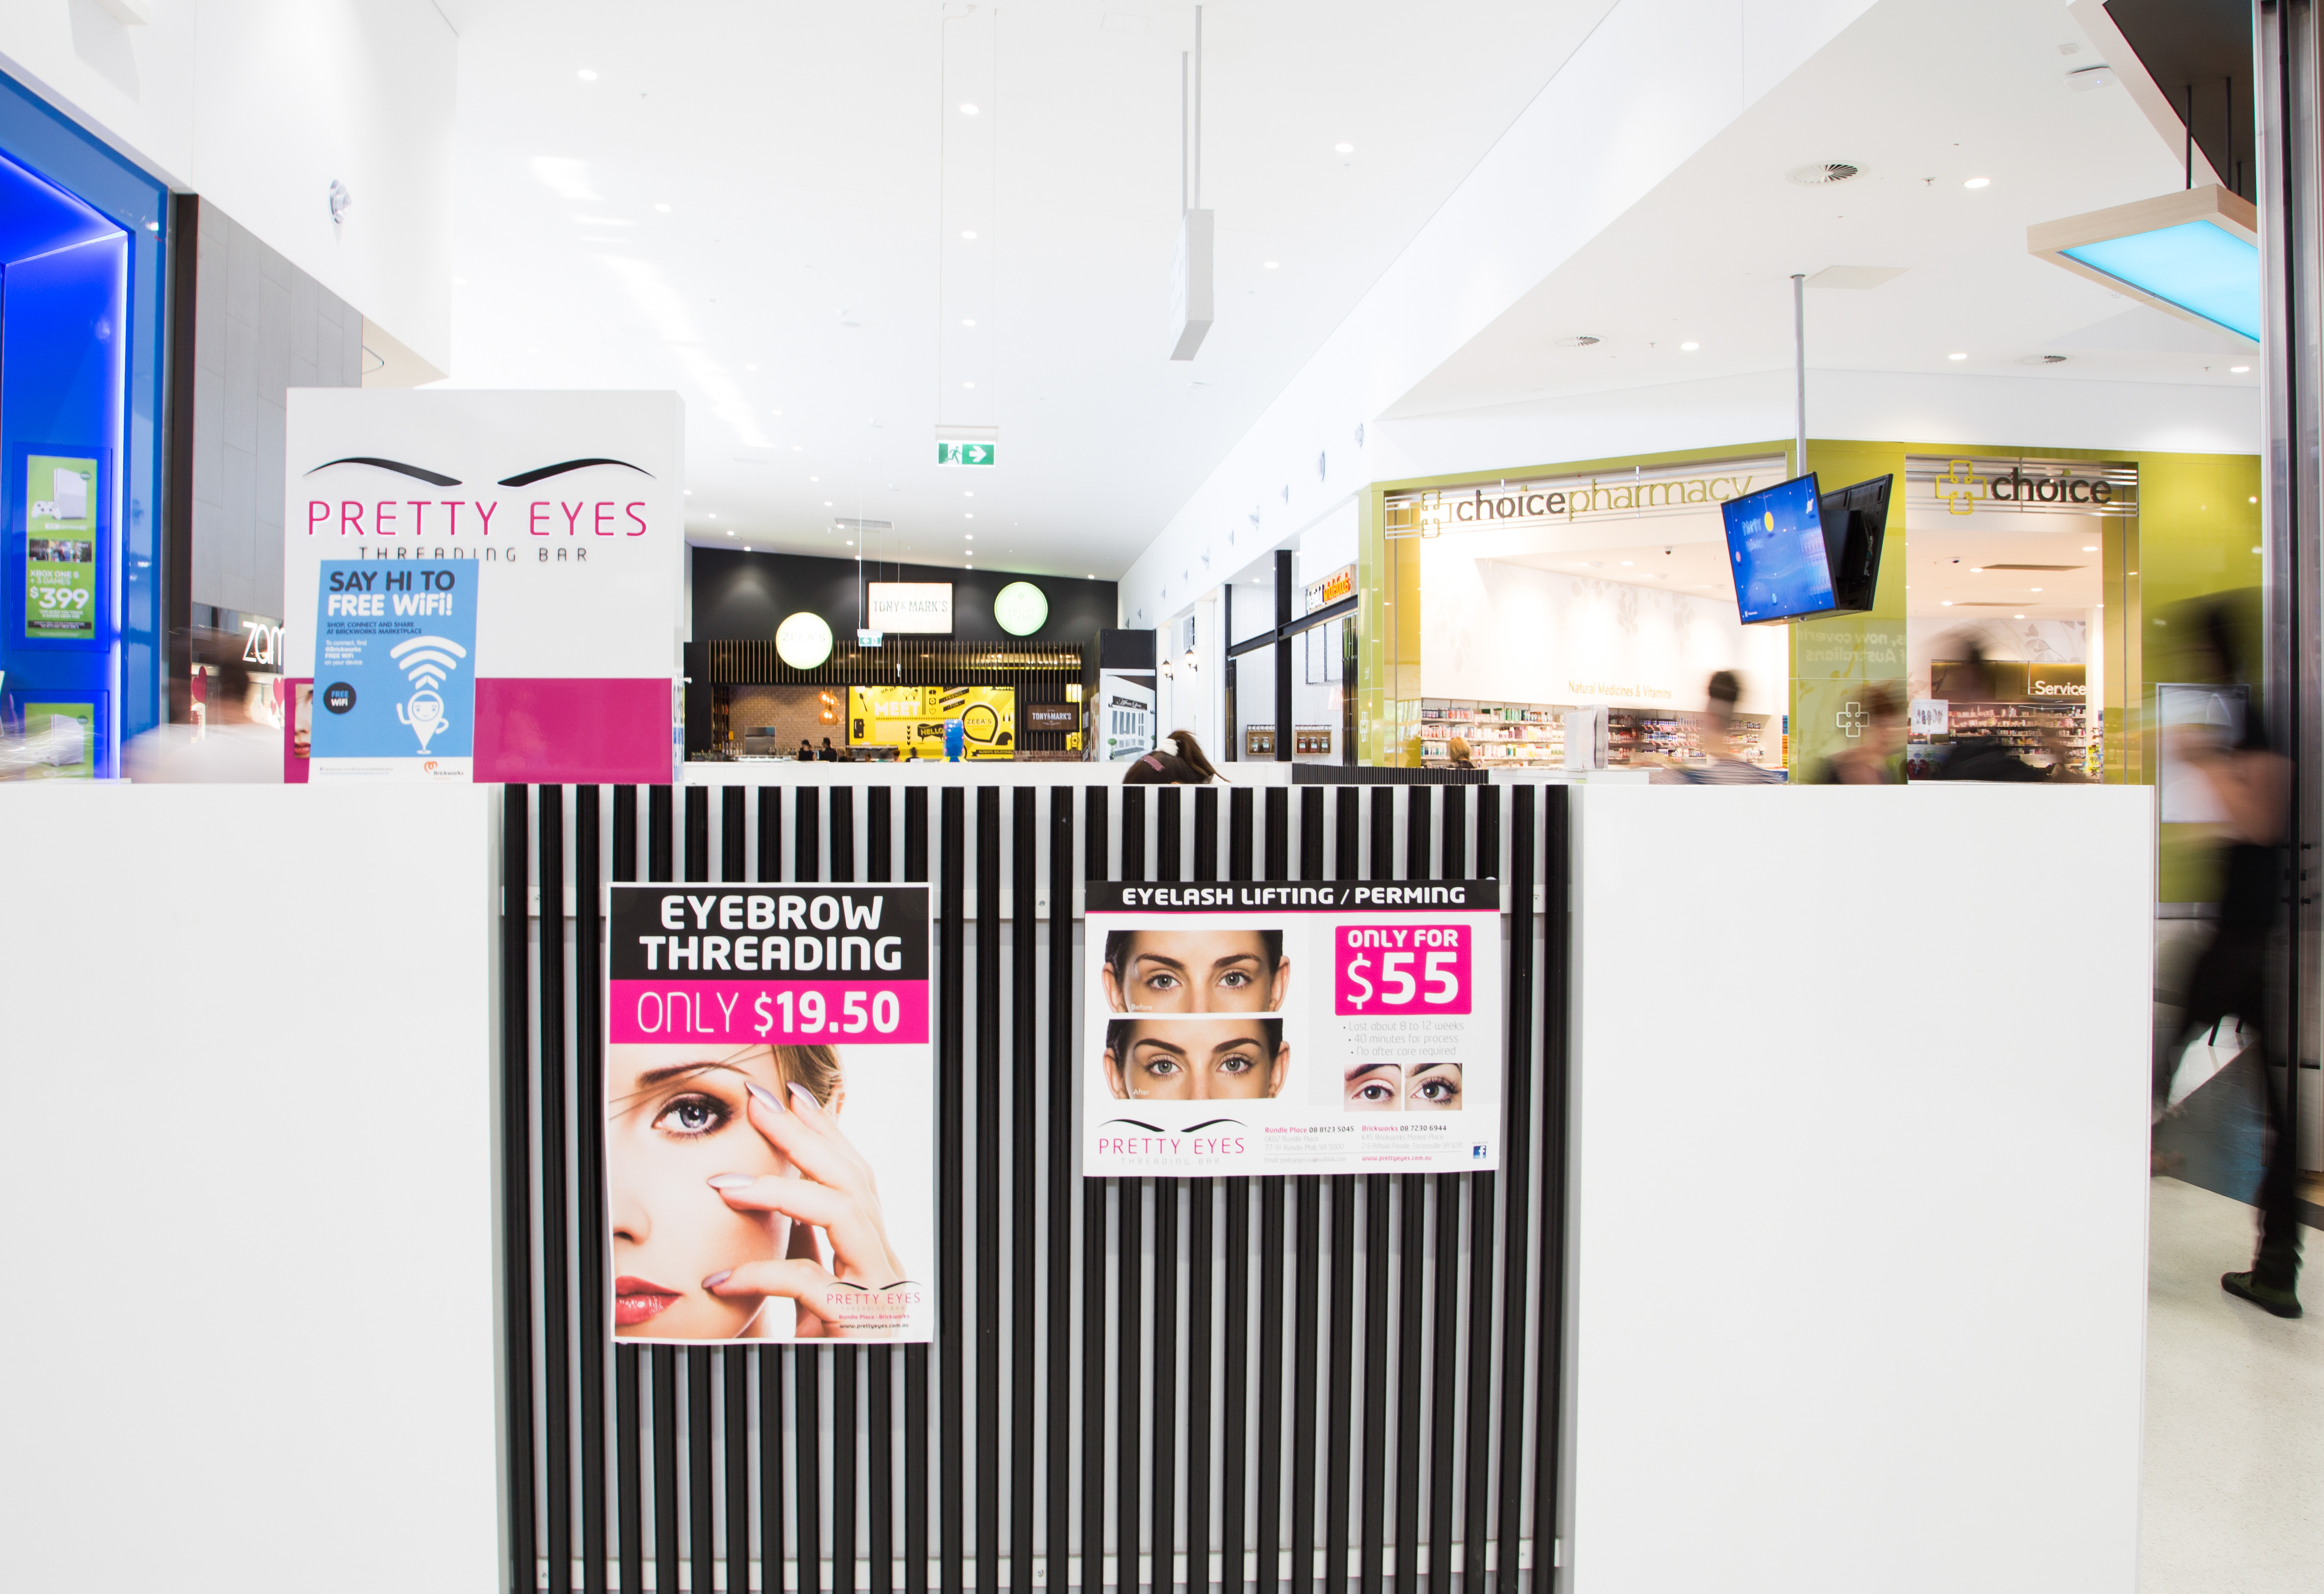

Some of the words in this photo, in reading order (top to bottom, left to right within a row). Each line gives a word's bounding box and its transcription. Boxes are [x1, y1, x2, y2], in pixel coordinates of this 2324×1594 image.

[1991, 467, 2112, 504] choice
[308, 500, 498, 536] PRETTY
[529, 501, 647, 537] EYES
[358, 547, 516, 561] THREADING
[539, 547, 587, 562] BAR
[43, 577, 71, 586] GAMES
[54, 570, 72, 578] ONE
[329, 571, 377, 592] SAY
[386, 571, 412, 591] HI
[421, 570, 455, 591] TO
[30, 586, 89, 610] $399
[327, 594, 384, 617] FREE
[392, 592, 452, 617] WiFi!
[873, 601, 899, 612] TONY
[909, 601, 948, 612] MARK'S
[1568, 680, 1596, 694] Natural
[1598, 682, 1634, 697] Medicines
[1636, 685, 1641, 697] &
[1643, 685, 1672, 699] Vitamins
[2035, 680, 2086, 695] Service
[331, 698, 348, 707] WiFi
[875, 701, 920, 716] MEET
[1122, 888, 1233, 906] EYELASH
[1241, 887, 1334, 905] LIFTING
[1340, 888, 1350, 905] /
[1354, 886, 1466, 905] PERMING
[661, 895, 883, 930] EYEBROW
[1348, 930, 1408, 948] ONLY
[1414, 928, 1459, 947] FOR
[639, 935, 902, 971] THREADING
[1347, 951, 1459, 1010] $55
[638, 991, 739, 1033] ONLY
[754, 990, 900, 1037] $19.50
[1349, 1022, 1367, 1031] Last
[1371, 1022, 1397, 1031] about
[1399, 1021, 1407, 1031] 8
[1409, 1022, 1419, 1030] to
[1422, 1021, 1431, 1030] 12
[1435, 1021, 1464, 1030] weeks
[1354, 1034, 1366, 1044] 40
[1370, 1034, 1405, 1043] minutes
[1408, 1034, 1421, 1043] for
[1423, 1035, 1458, 1045] process
[1356, 1046, 1369, 1056] No
[1372, 1046, 1394, 1056] after
[1419, 1046, 1456, 1057] required
[1099, 1138, 1181, 1154] PRETTY
[1194, 1138, 1244, 1154] EYES
[1121, 1157, 1190, 1166] THREADING
[827, 1293, 879, 1305] PRETTY
[887, 1292, 921, 1304] EYES
